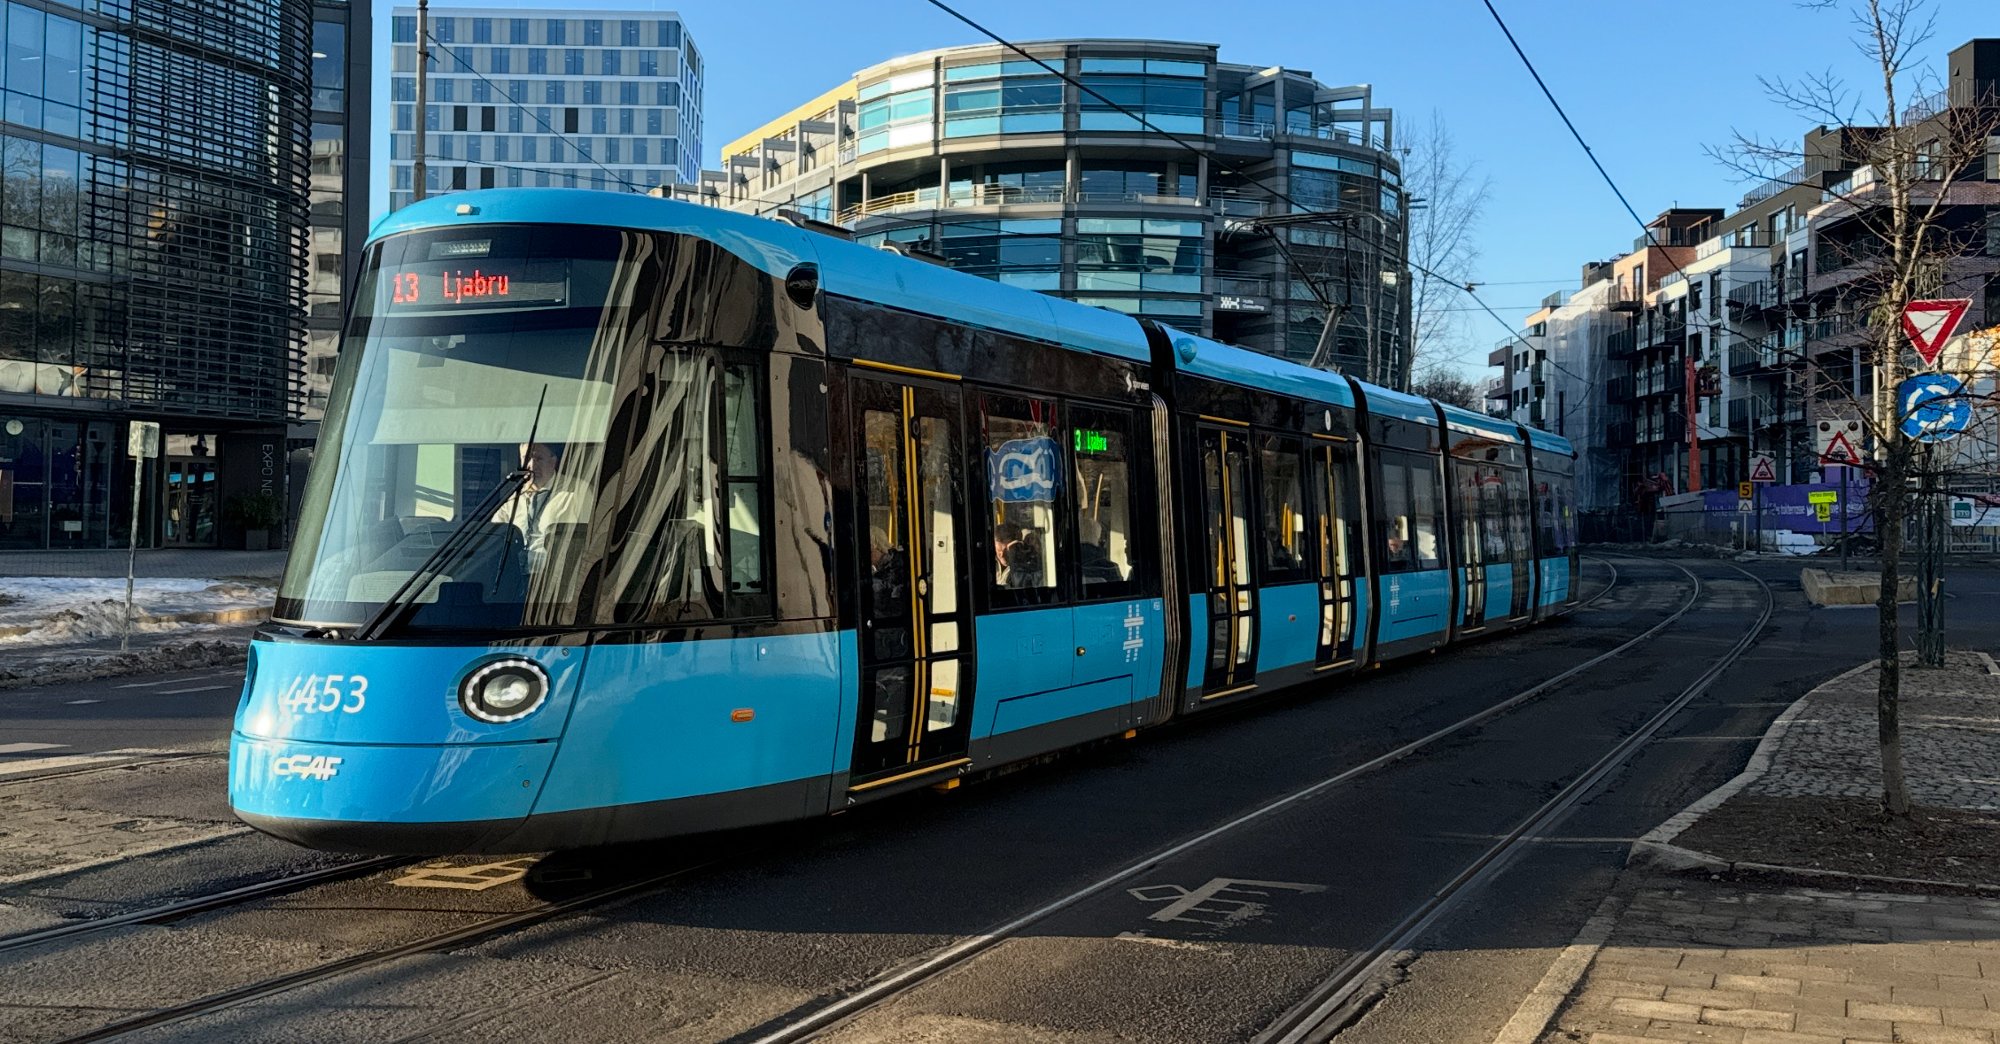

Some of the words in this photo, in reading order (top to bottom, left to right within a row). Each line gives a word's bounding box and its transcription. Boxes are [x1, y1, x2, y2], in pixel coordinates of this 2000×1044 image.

[393, 272, 419, 304] 13
[443, 269, 509, 304] Ljabru
[261, 444, 274, 476] EXPO
[1741, 484, 1751, 497] 5
[282, 673, 369, 714] 4453
